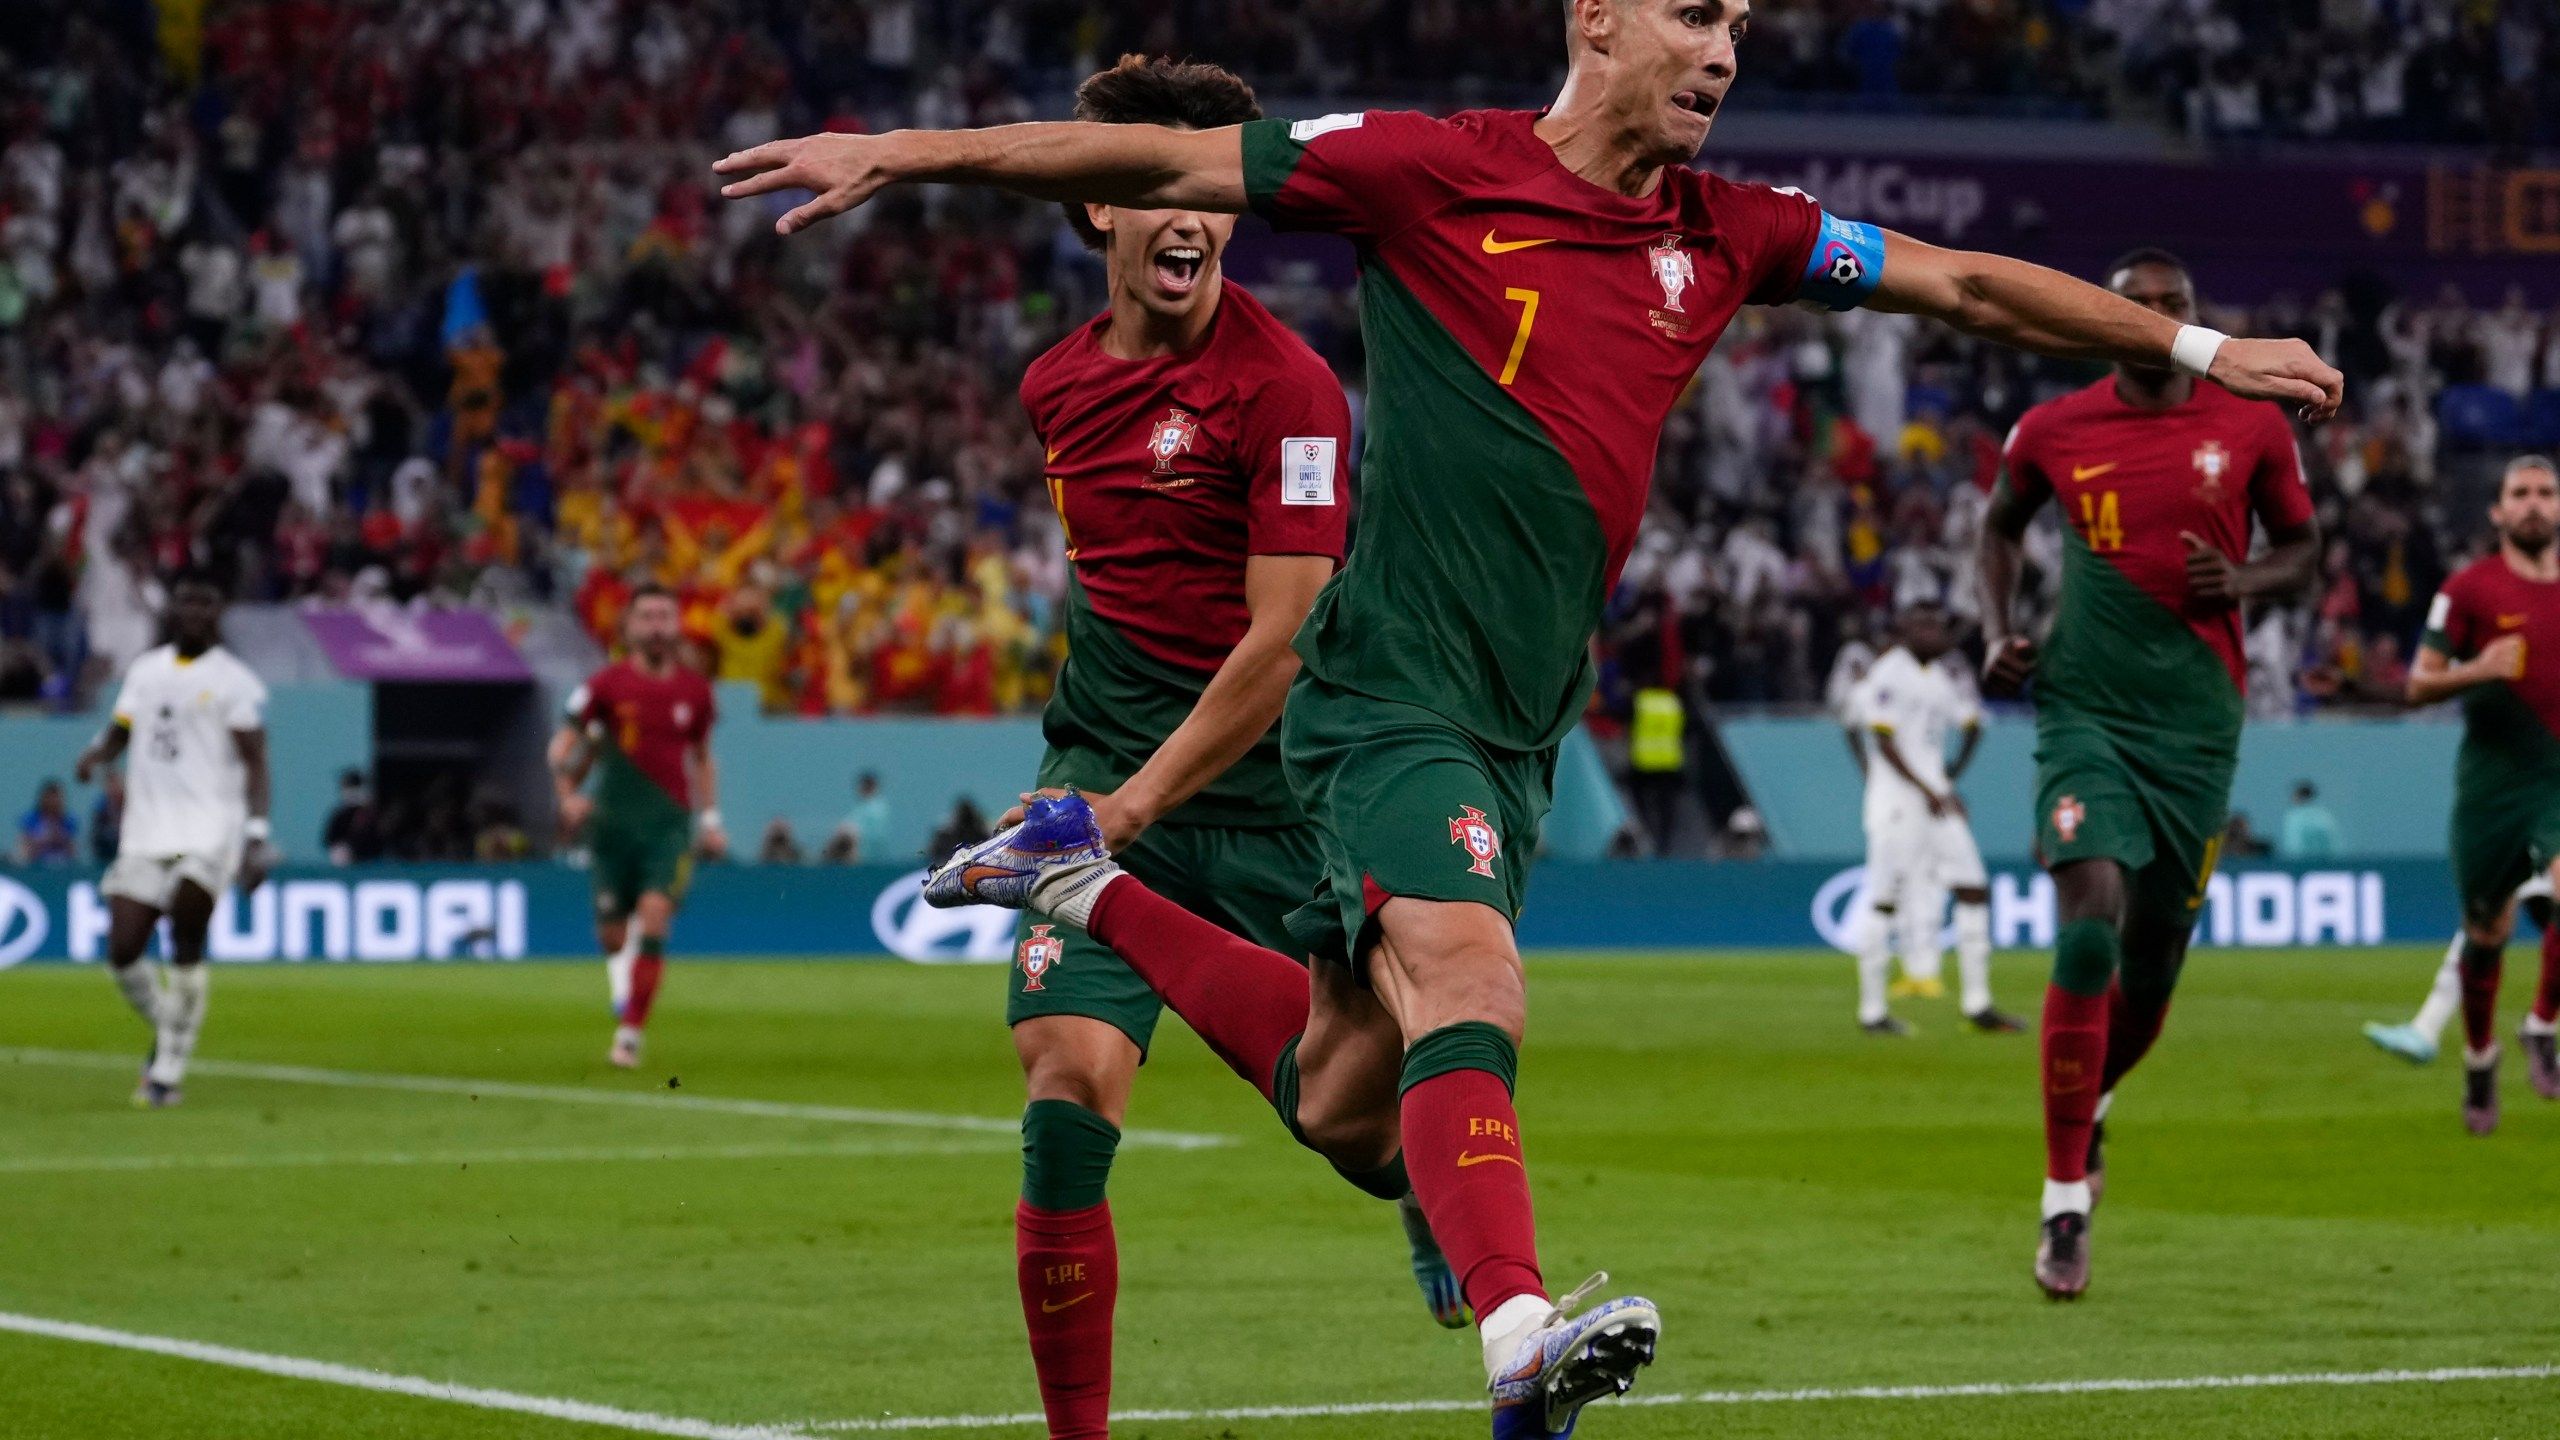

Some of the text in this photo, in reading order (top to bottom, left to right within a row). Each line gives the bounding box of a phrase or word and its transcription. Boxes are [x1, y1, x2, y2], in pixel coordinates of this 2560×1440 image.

[1700, 158, 1984, 240] ldCup
[1499, 287, 1539, 385] 7
[1299, 472, 1321, 480] UNITES
[2080, 489, 2123, 550] 14
[67, 879, 526, 962] HUNDAI
